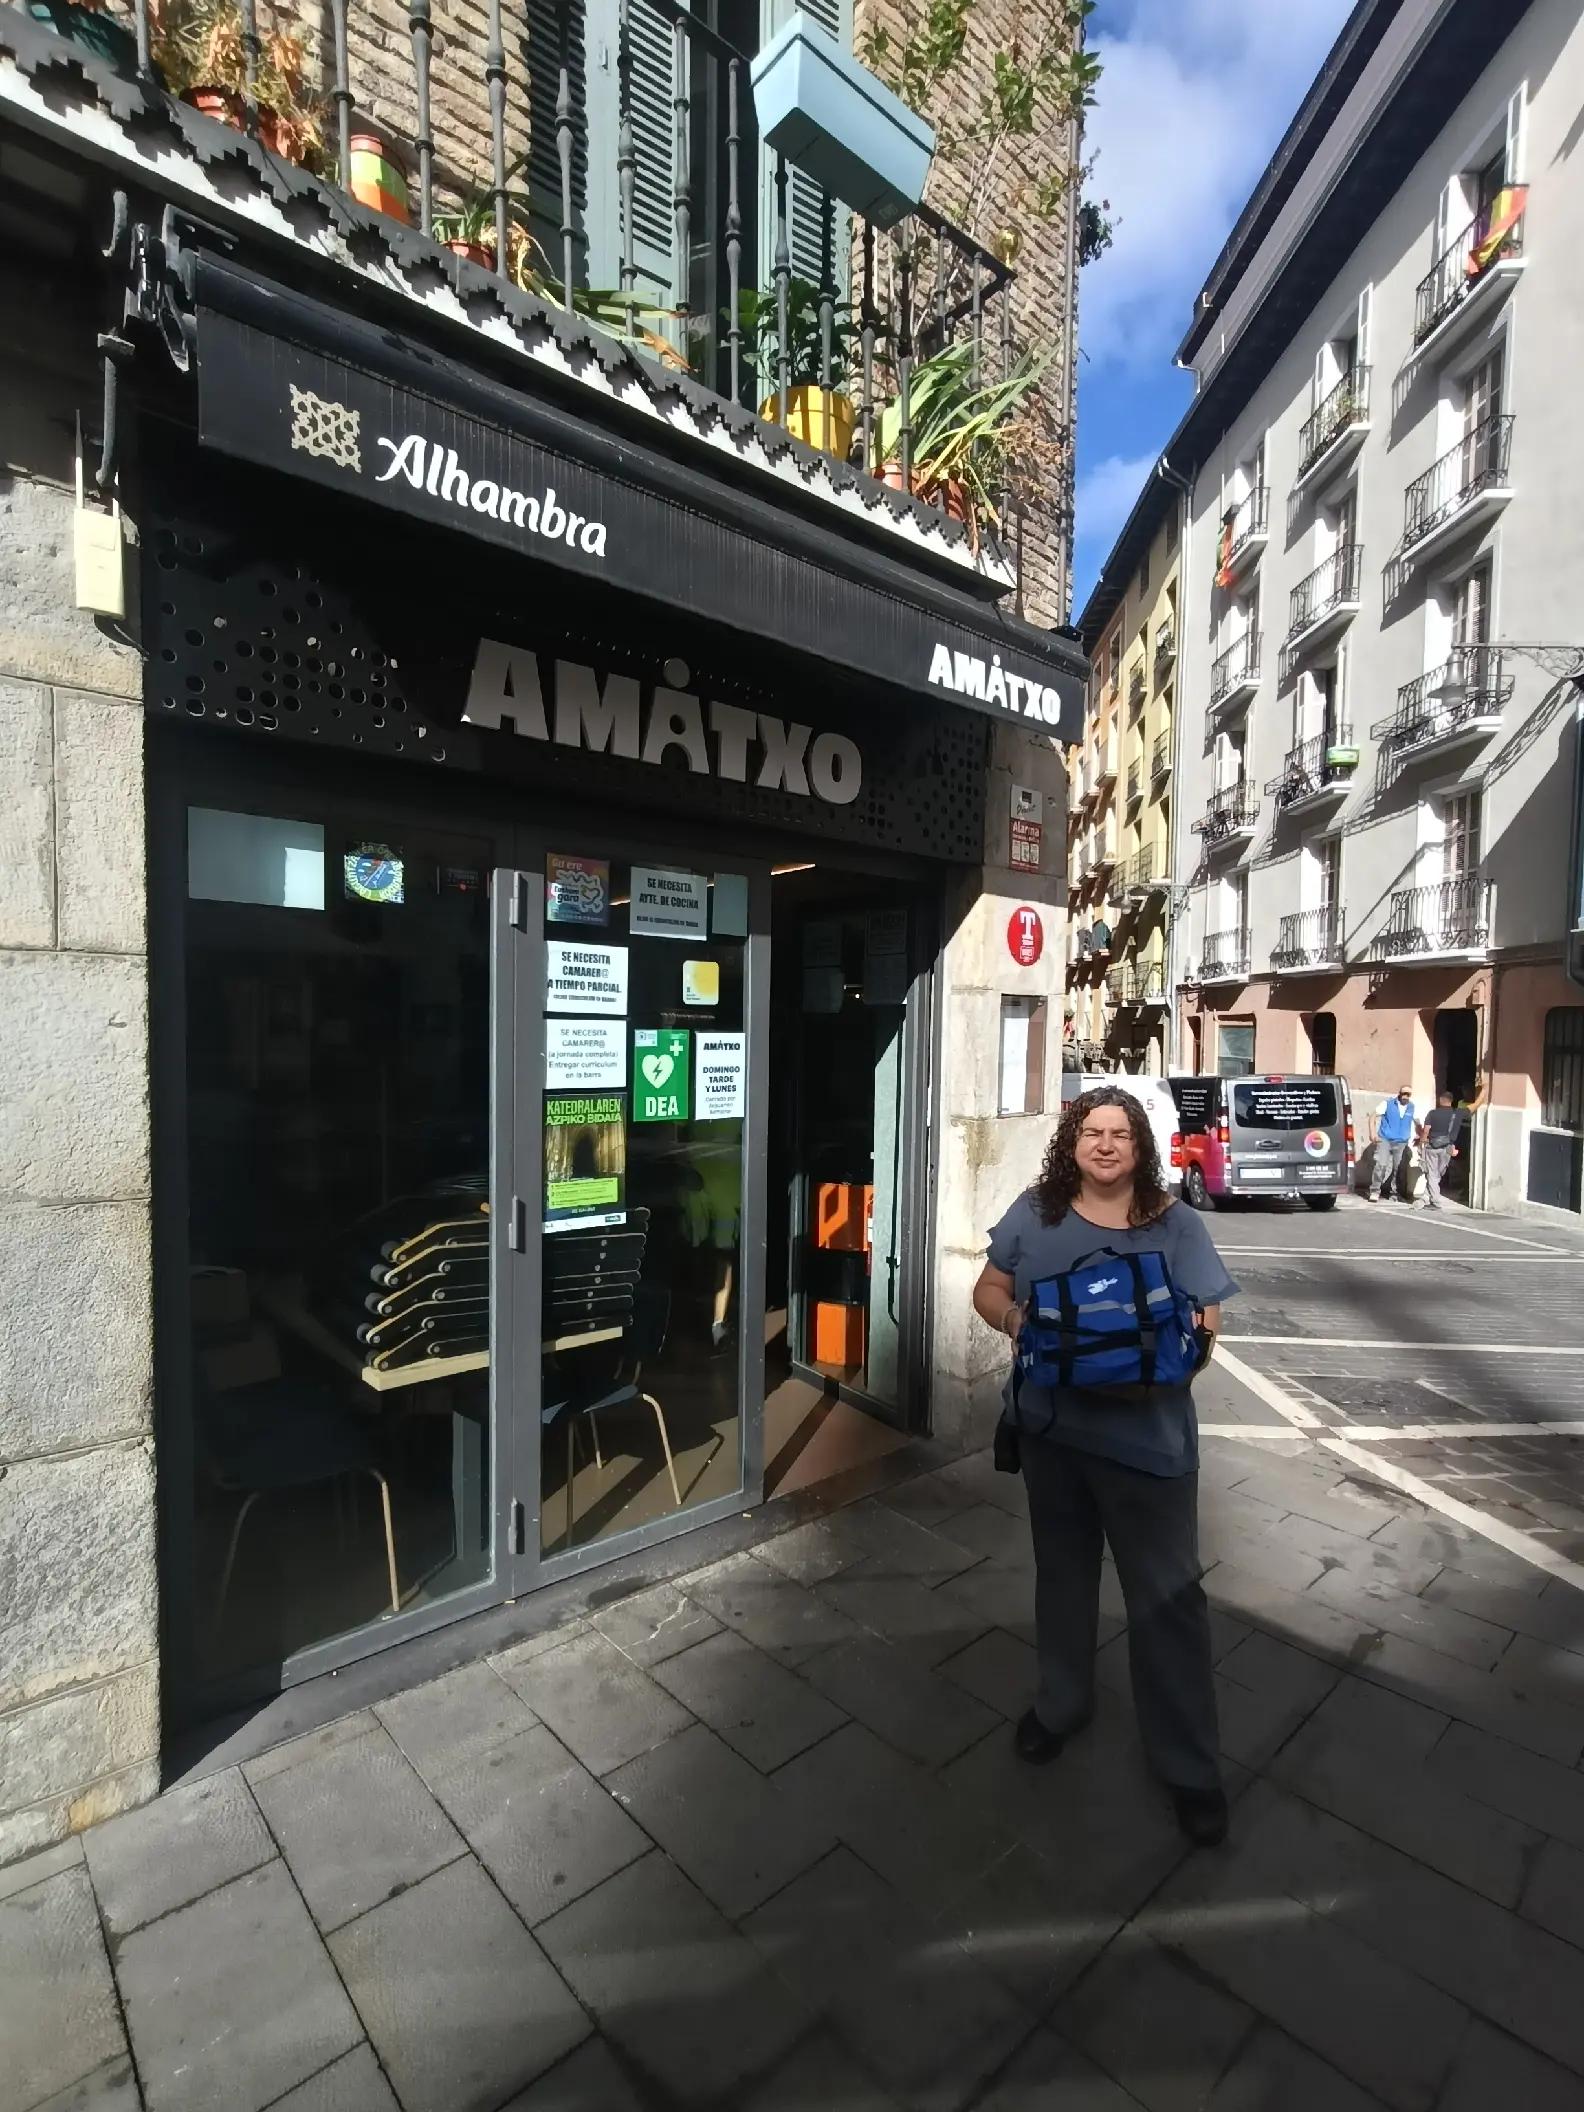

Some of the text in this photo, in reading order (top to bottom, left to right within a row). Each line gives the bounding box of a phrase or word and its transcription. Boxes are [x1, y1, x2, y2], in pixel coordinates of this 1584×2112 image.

[375, 434, 607, 556] Alhambra
[1013, 821, 1040, 838] Alarma
[647, 878, 692, 893] SE NECESITA
[660, 895, 669, 906] DE
[670, 897, 699, 909] COCINA
[561, 951, 611, 965] SE NECESITA
[547, 979, 622, 993] A TIEMPO PARCIAL
[556, 1051, 583, 1059] jornada
[548, 1061, 579, 1069] Entregar
[703, 1066, 741, 1074] DOMINGO
[705, 1085, 737, 1093] Y LUNES
[547, 1099, 621, 1115] KATEDRALAREN
[645, 1096, 679, 1117] DEA
[546, 1112, 622, 1126] AZPIKO BIDAIA
